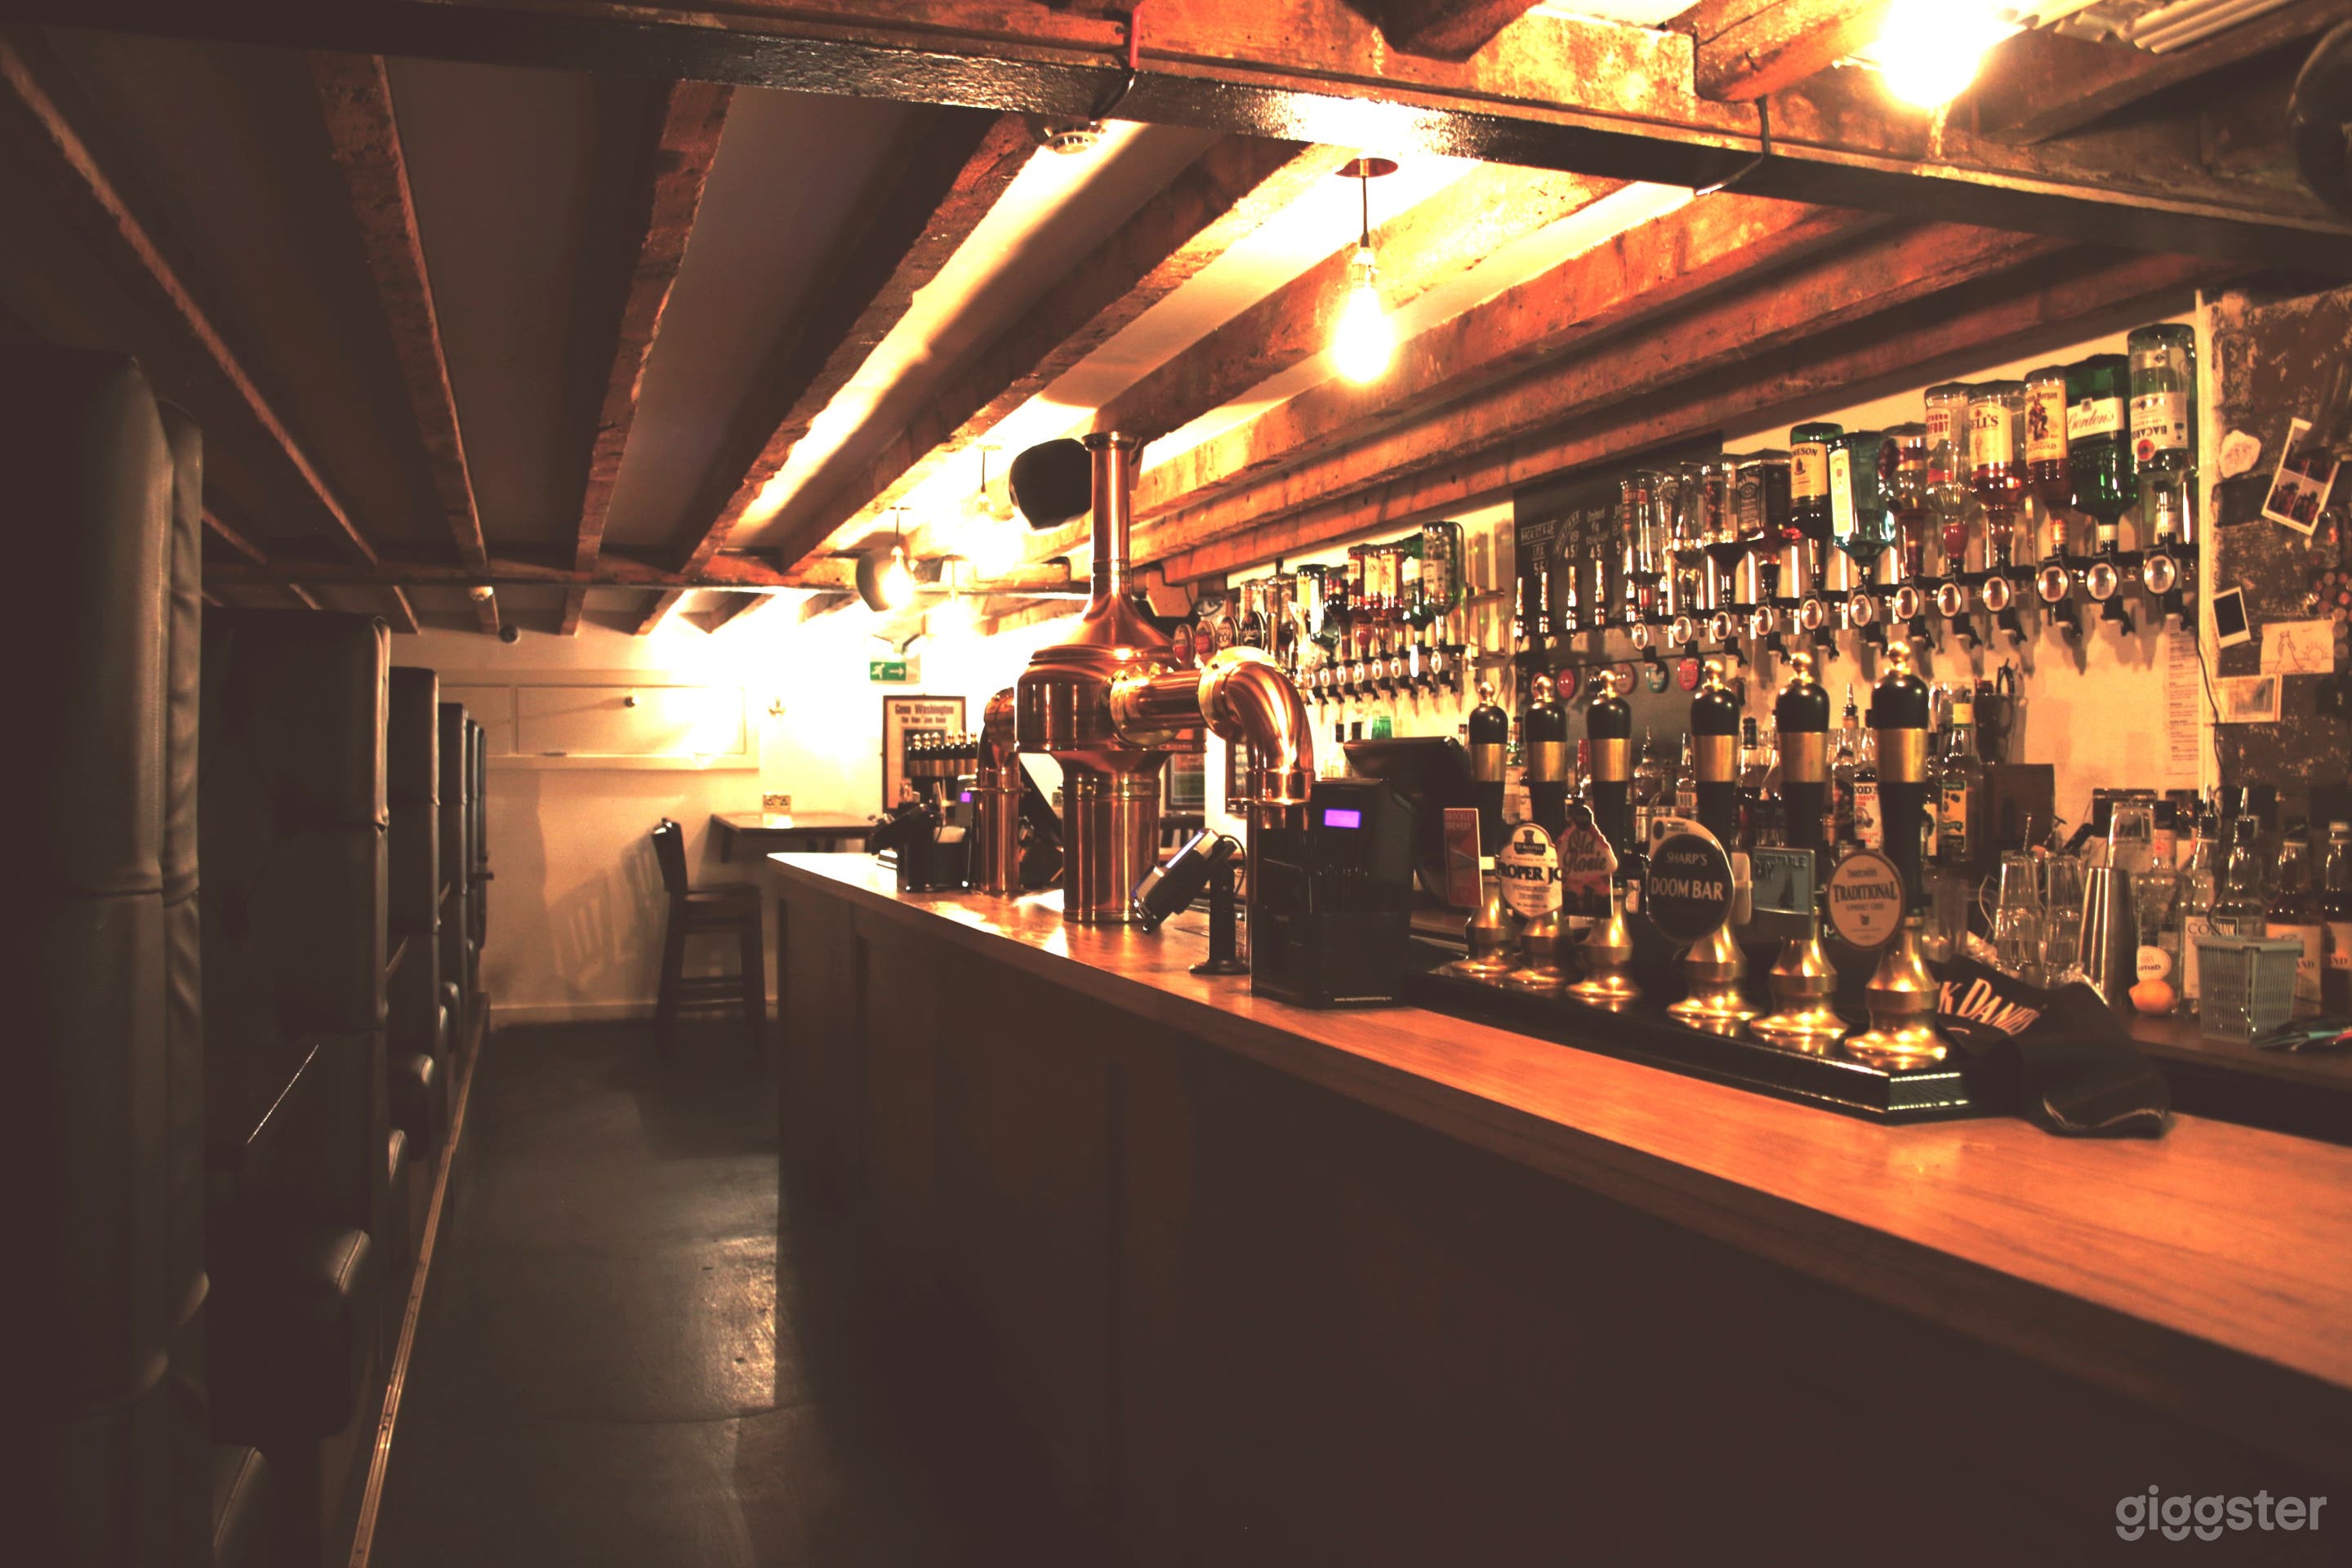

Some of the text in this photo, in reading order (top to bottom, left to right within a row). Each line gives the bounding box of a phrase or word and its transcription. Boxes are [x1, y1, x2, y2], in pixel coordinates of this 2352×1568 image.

[1927, 421, 1949, 434] FORT
[1971, 413, 1999, 430] ELL'S
[2068, 410, 2115, 431] Gordon's
[1854, 785, 1877, 795] OD'S
[1666, 852, 1708, 866] SHARP'S
[1497, 862, 1544, 881] PROPER
[1650, 876, 1724, 901] DOOM BAR
[1832, 880, 1898, 903] TRADITIONAL
